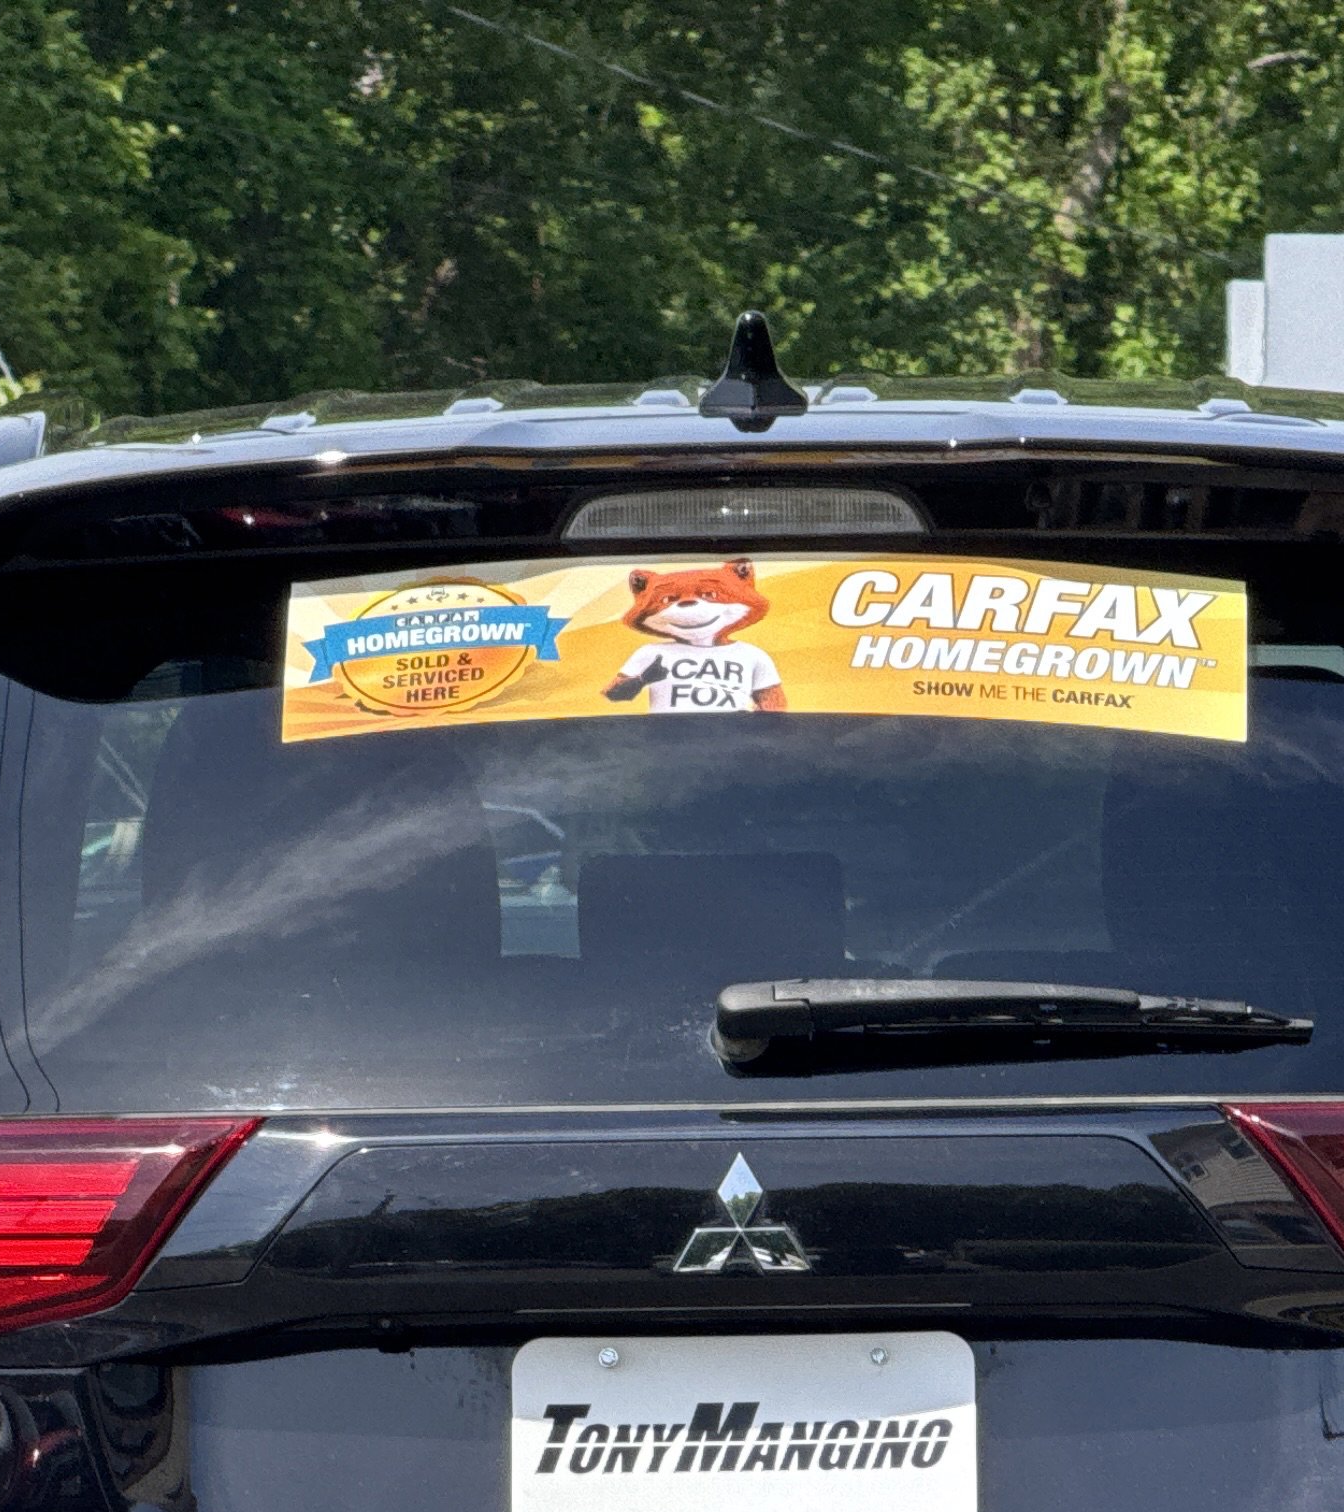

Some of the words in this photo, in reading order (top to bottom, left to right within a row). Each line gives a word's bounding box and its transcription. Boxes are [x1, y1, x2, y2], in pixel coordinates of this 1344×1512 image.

[829, 570, 1220, 648] CARFAX
[347, 622, 525, 655] HOMEGROWN
[396, 654, 449, 671] SOLD
[457, 652, 472, 666] &
[671, 659, 743, 683] CAR
[850, 634, 1197, 689] HOMEGROWN
[383, 667, 484, 689] SERVICED
[406, 686, 460, 703] HERE
[670, 684, 737, 708] FOX
[913, 680, 973, 698] SHOW
[979, 684, 1008, 700] ME
[1011, 685, 1047, 702] THE
[1052, 688, 1132, 708] CARFAX
